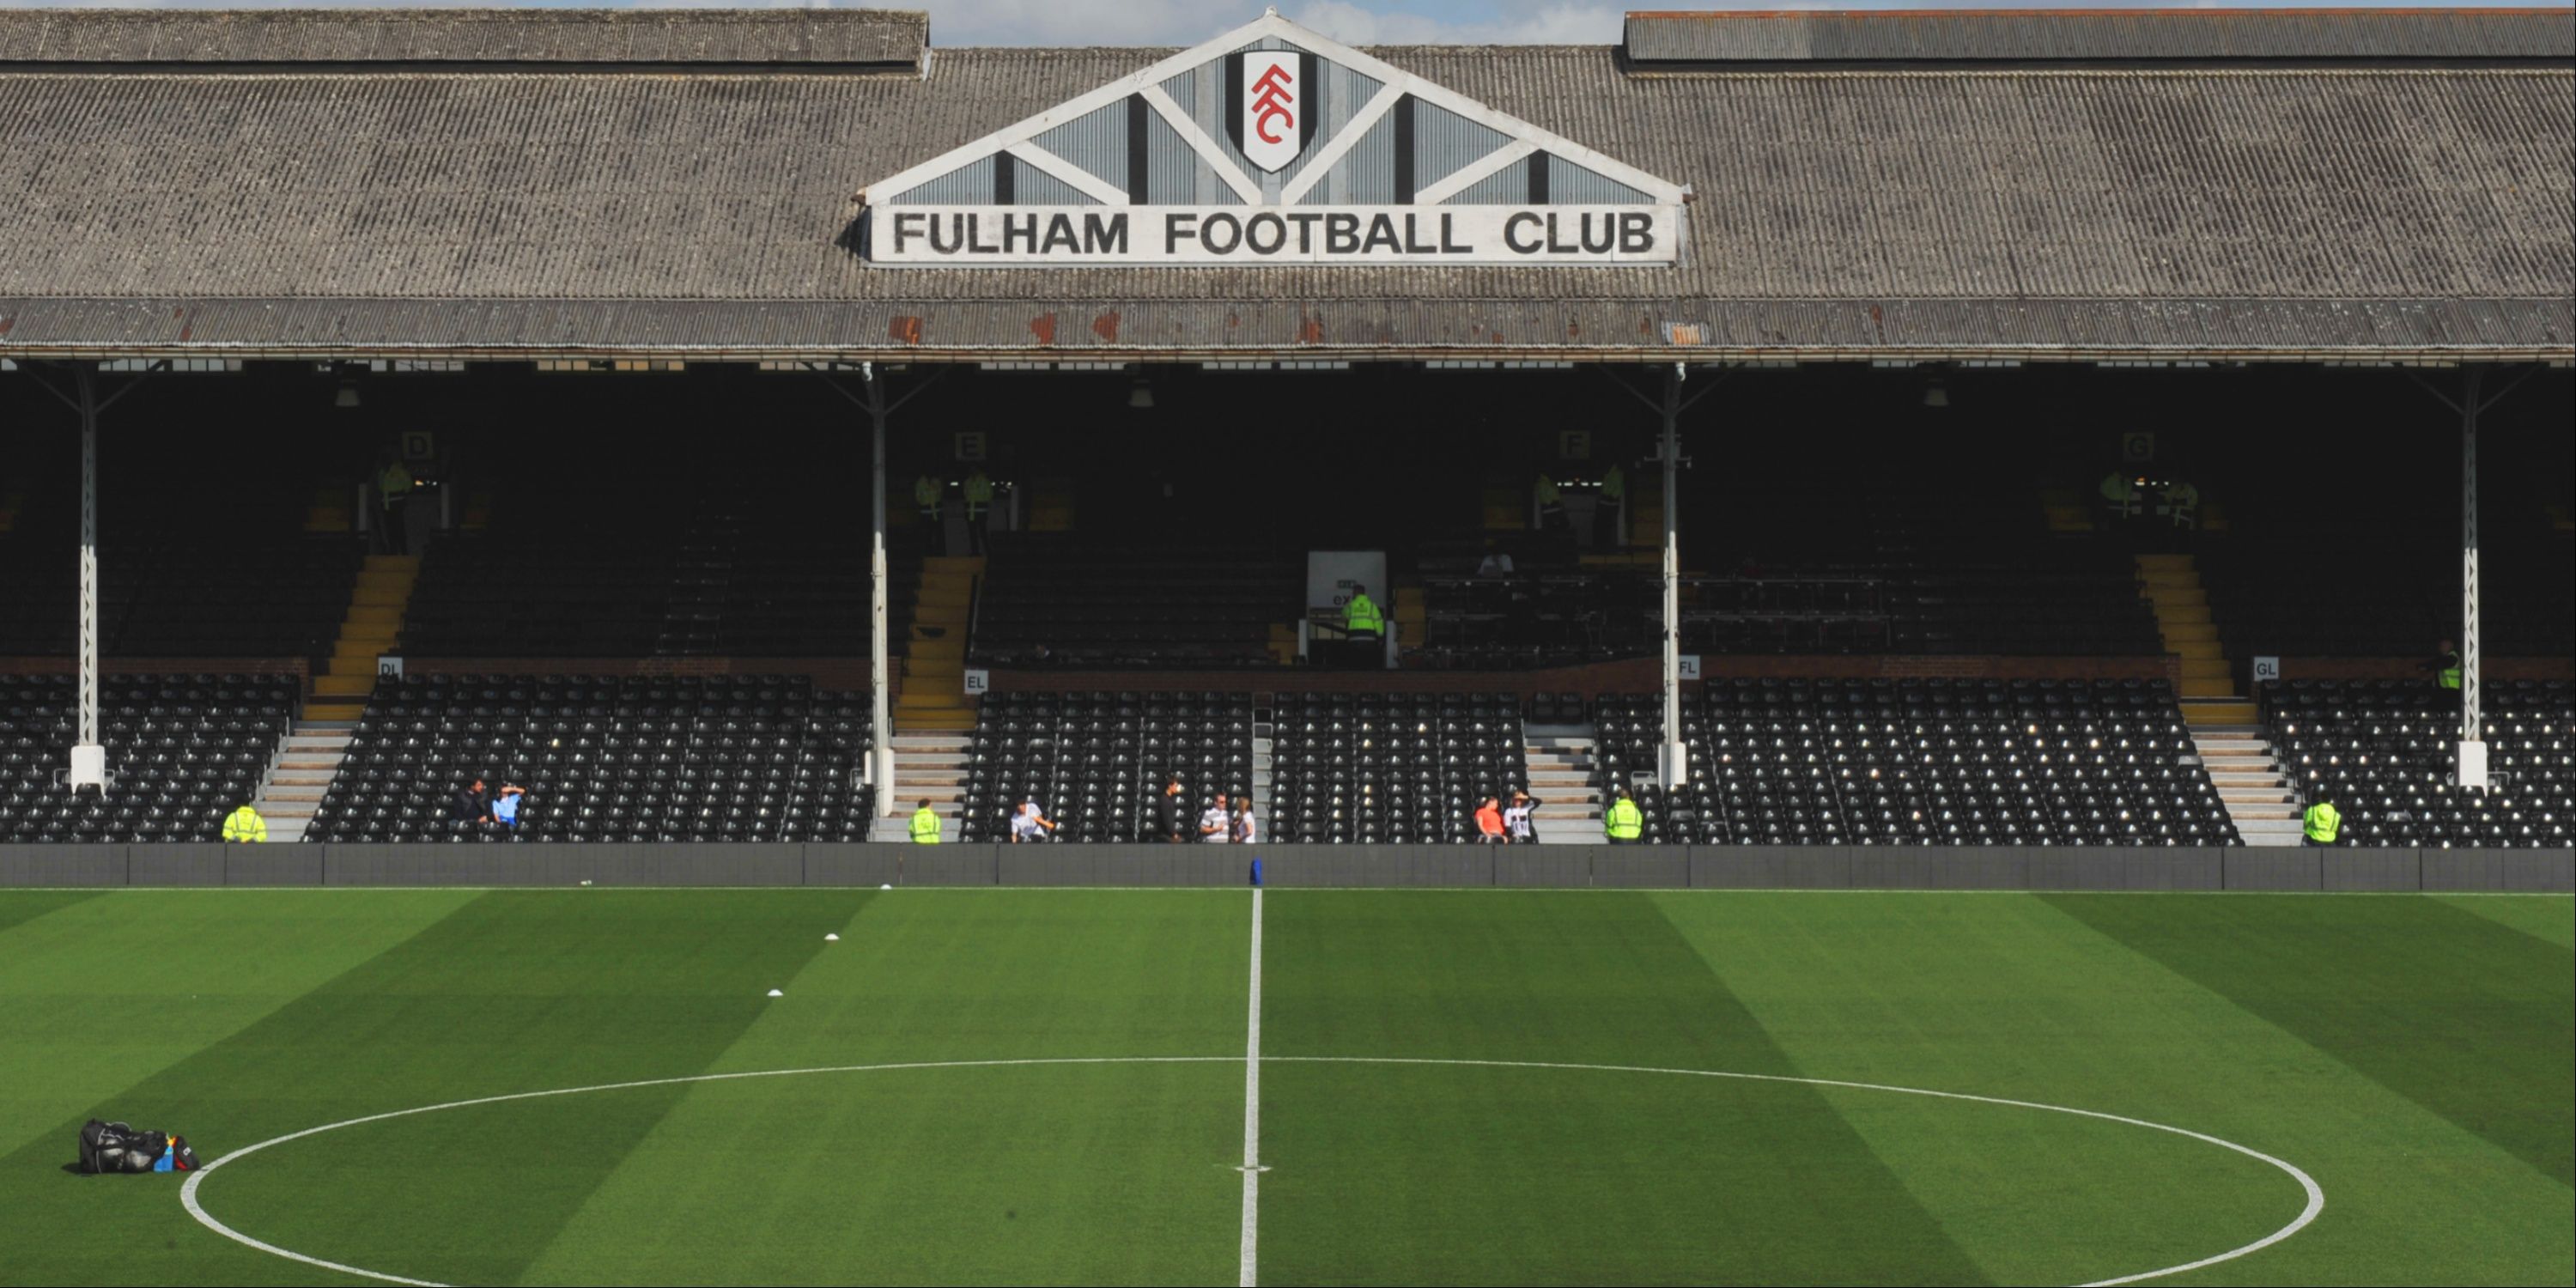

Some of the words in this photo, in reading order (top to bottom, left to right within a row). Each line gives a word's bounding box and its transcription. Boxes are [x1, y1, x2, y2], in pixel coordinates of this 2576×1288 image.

[1251, 64, 1294, 144] FFC
[894, 212, 1128, 254] FULHAM
[1165, 212, 1473, 254] FOOTBALL
[1504, 211, 1654, 254] CLUB
[409, 435, 428, 455] D
[961, 435, 977, 456] E
[1567, 434, 1583, 455] F
[2129, 436, 2148, 457] G
[1334, 594, 1351, 605] ex
[1680, 661, 1696, 673] FL
[2257, 663, 2276, 675] GL
[968, 677, 985, 688] EL
